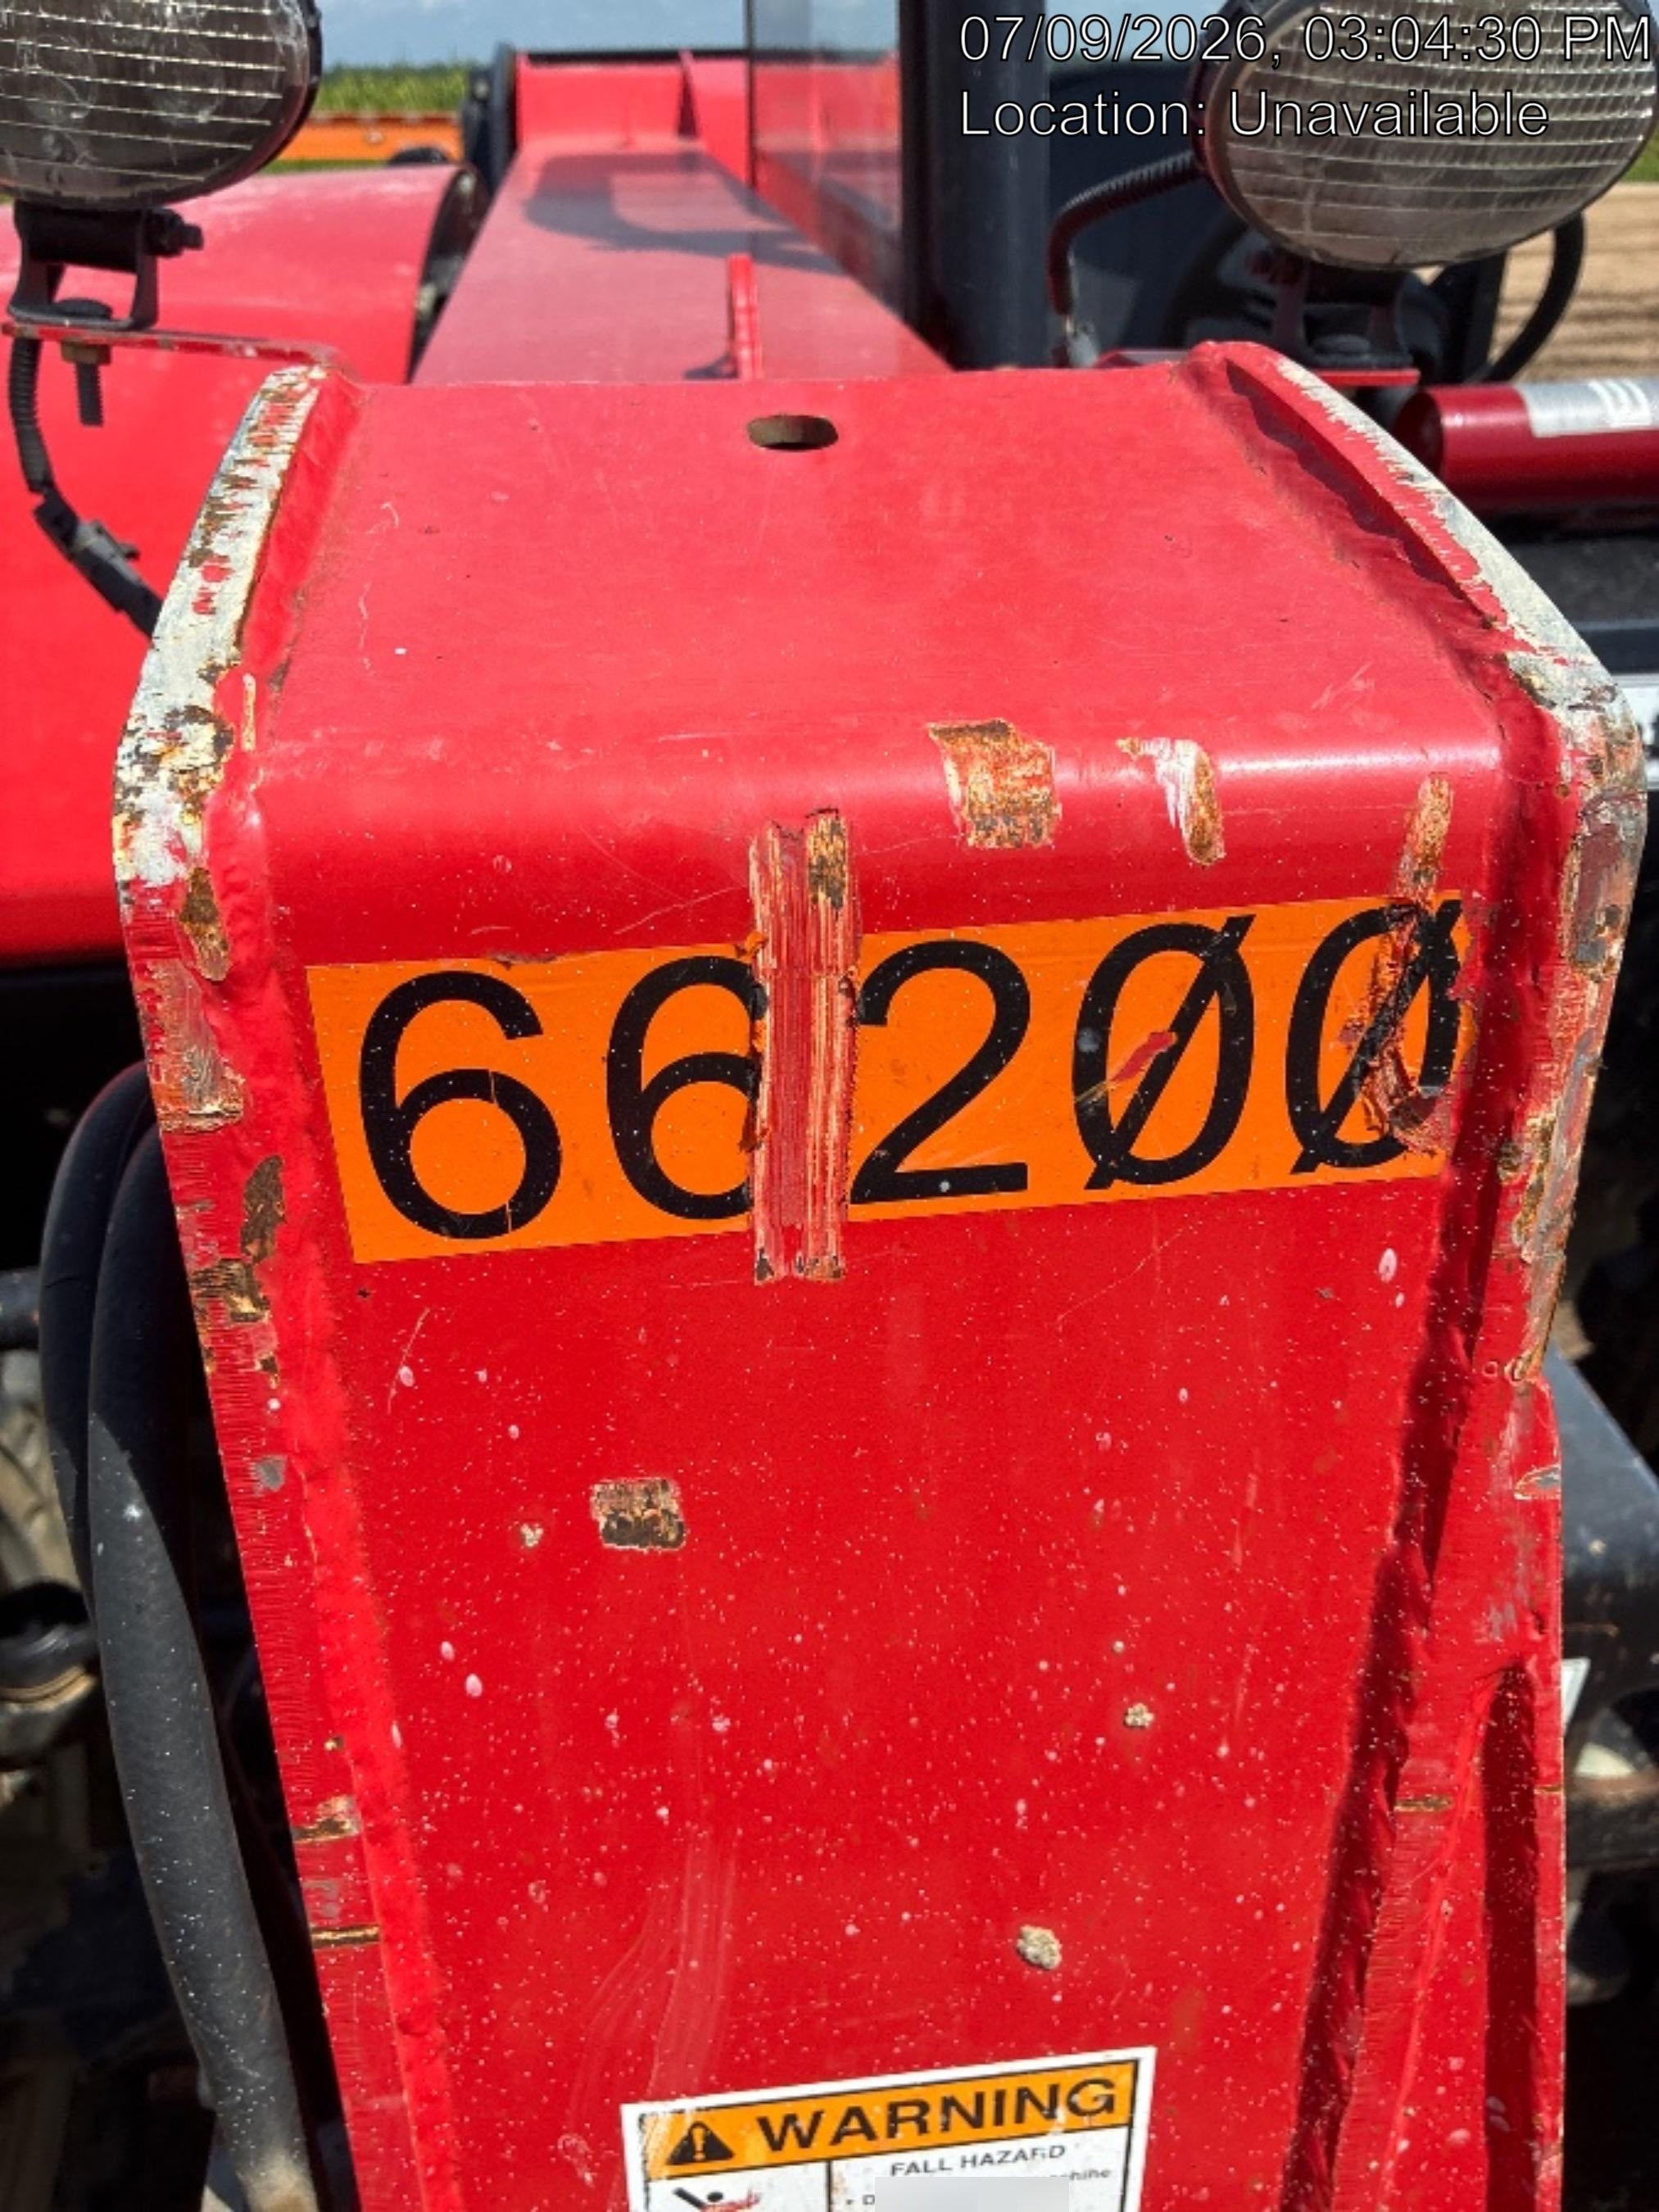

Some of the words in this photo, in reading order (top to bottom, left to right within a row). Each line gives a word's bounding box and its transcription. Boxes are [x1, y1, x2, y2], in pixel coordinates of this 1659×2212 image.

[758, 2077, 1116, 2151] WARNING
[891, 2158, 953, 2177] FALL
[960, 2145, 1066, 2169] HAZARD
